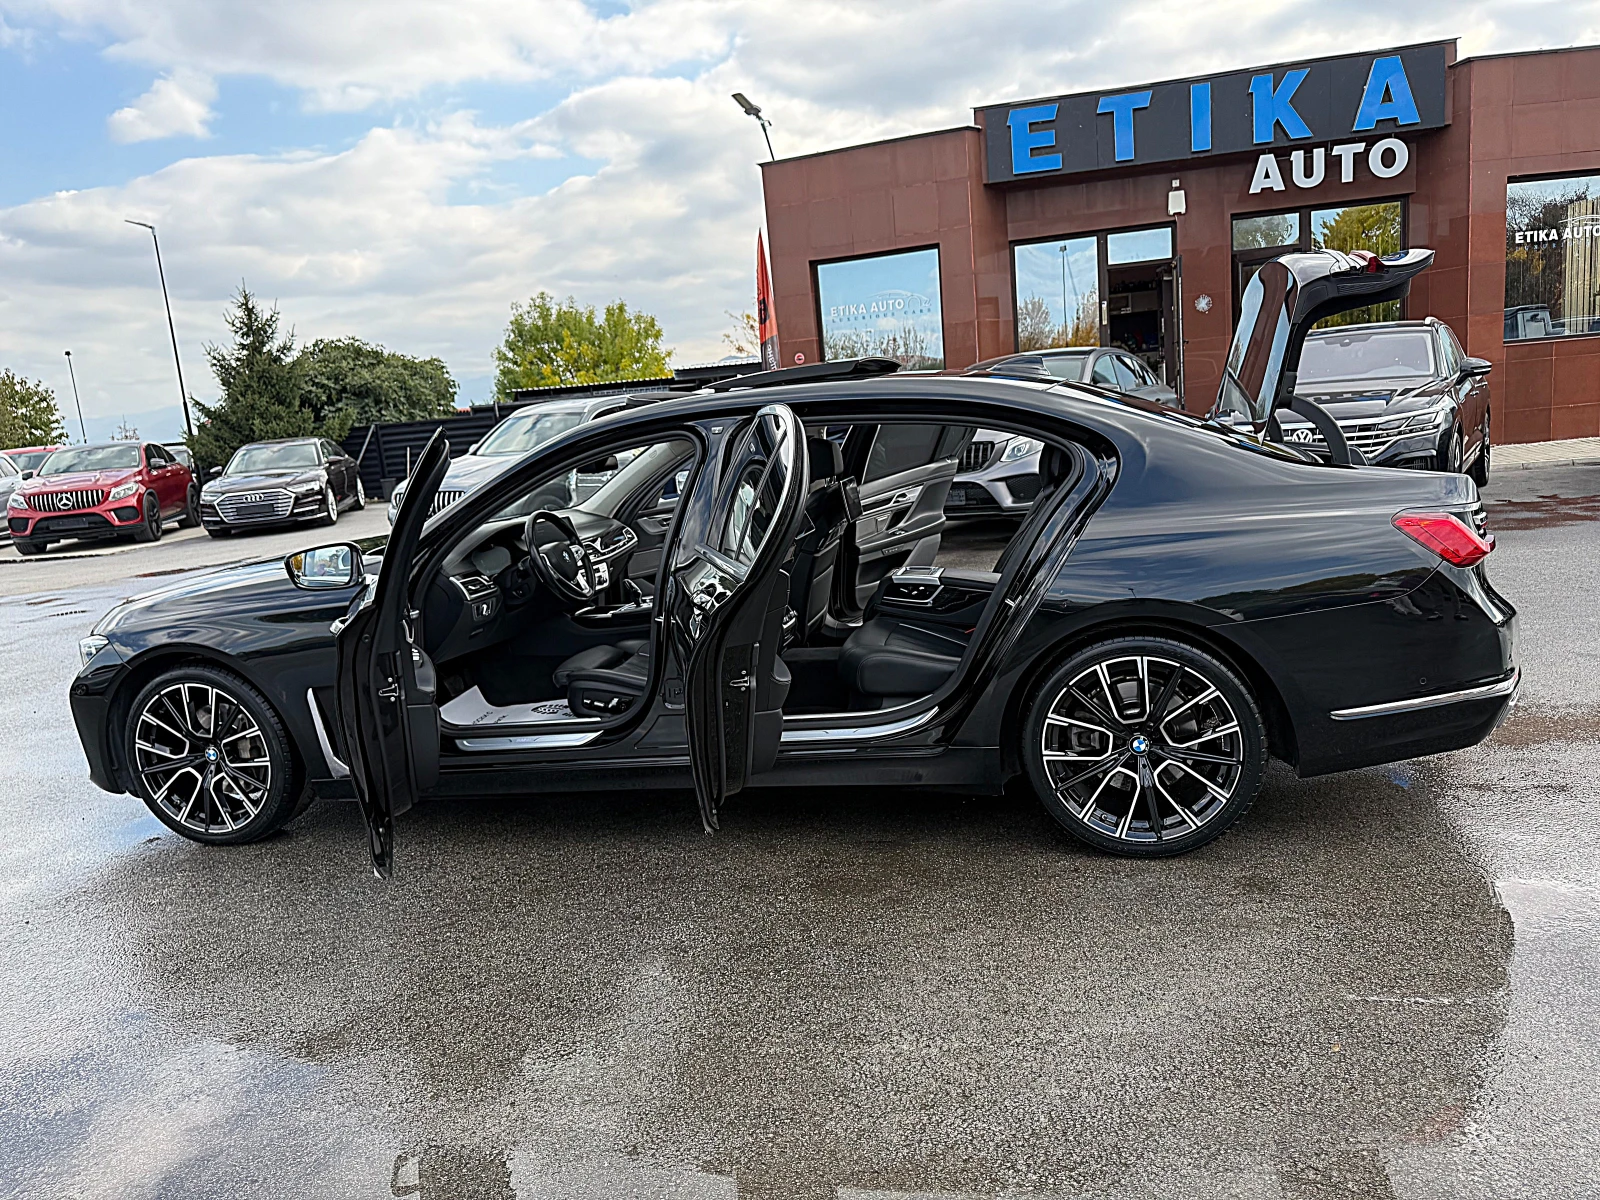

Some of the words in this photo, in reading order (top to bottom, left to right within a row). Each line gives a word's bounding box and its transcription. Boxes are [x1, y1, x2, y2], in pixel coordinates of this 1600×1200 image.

[1006, 55, 1421, 175] ETIKA
[1249, 138, 1409, 194] AUTO
[1515, 228, 1559, 244] ETIKA
[1562, 225, 1600, 240] AUTO
[830, 302, 867, 317] ETIKA
[870, 299, 905, 313] AUTO
